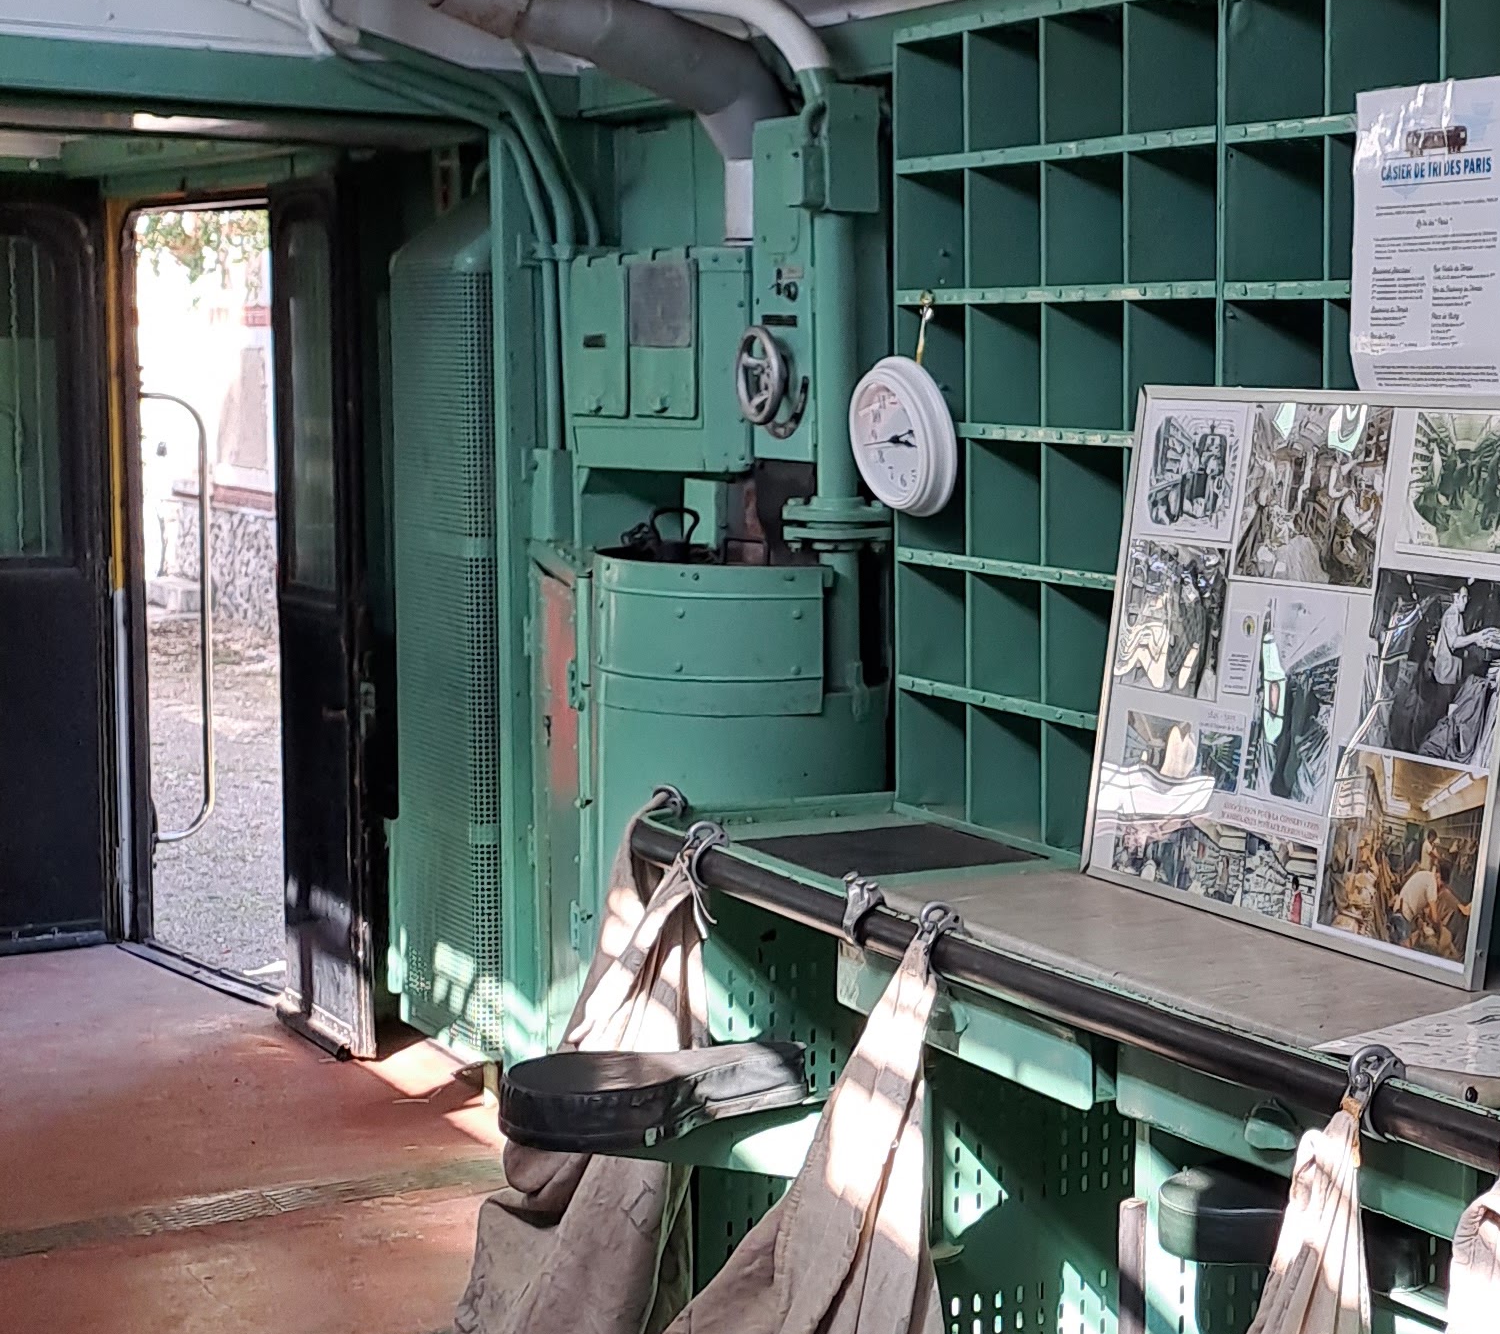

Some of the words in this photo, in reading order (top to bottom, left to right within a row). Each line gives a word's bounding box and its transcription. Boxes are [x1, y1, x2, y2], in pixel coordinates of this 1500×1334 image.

[1381, 162, 1412, 181] CASIER
[1414, 162, 1425, 179] DE
[1428, 160, 1441, 177] TRI
[1444, 159, 1461, 176] DES
[1463, 156, 1492, 174] PARIS
